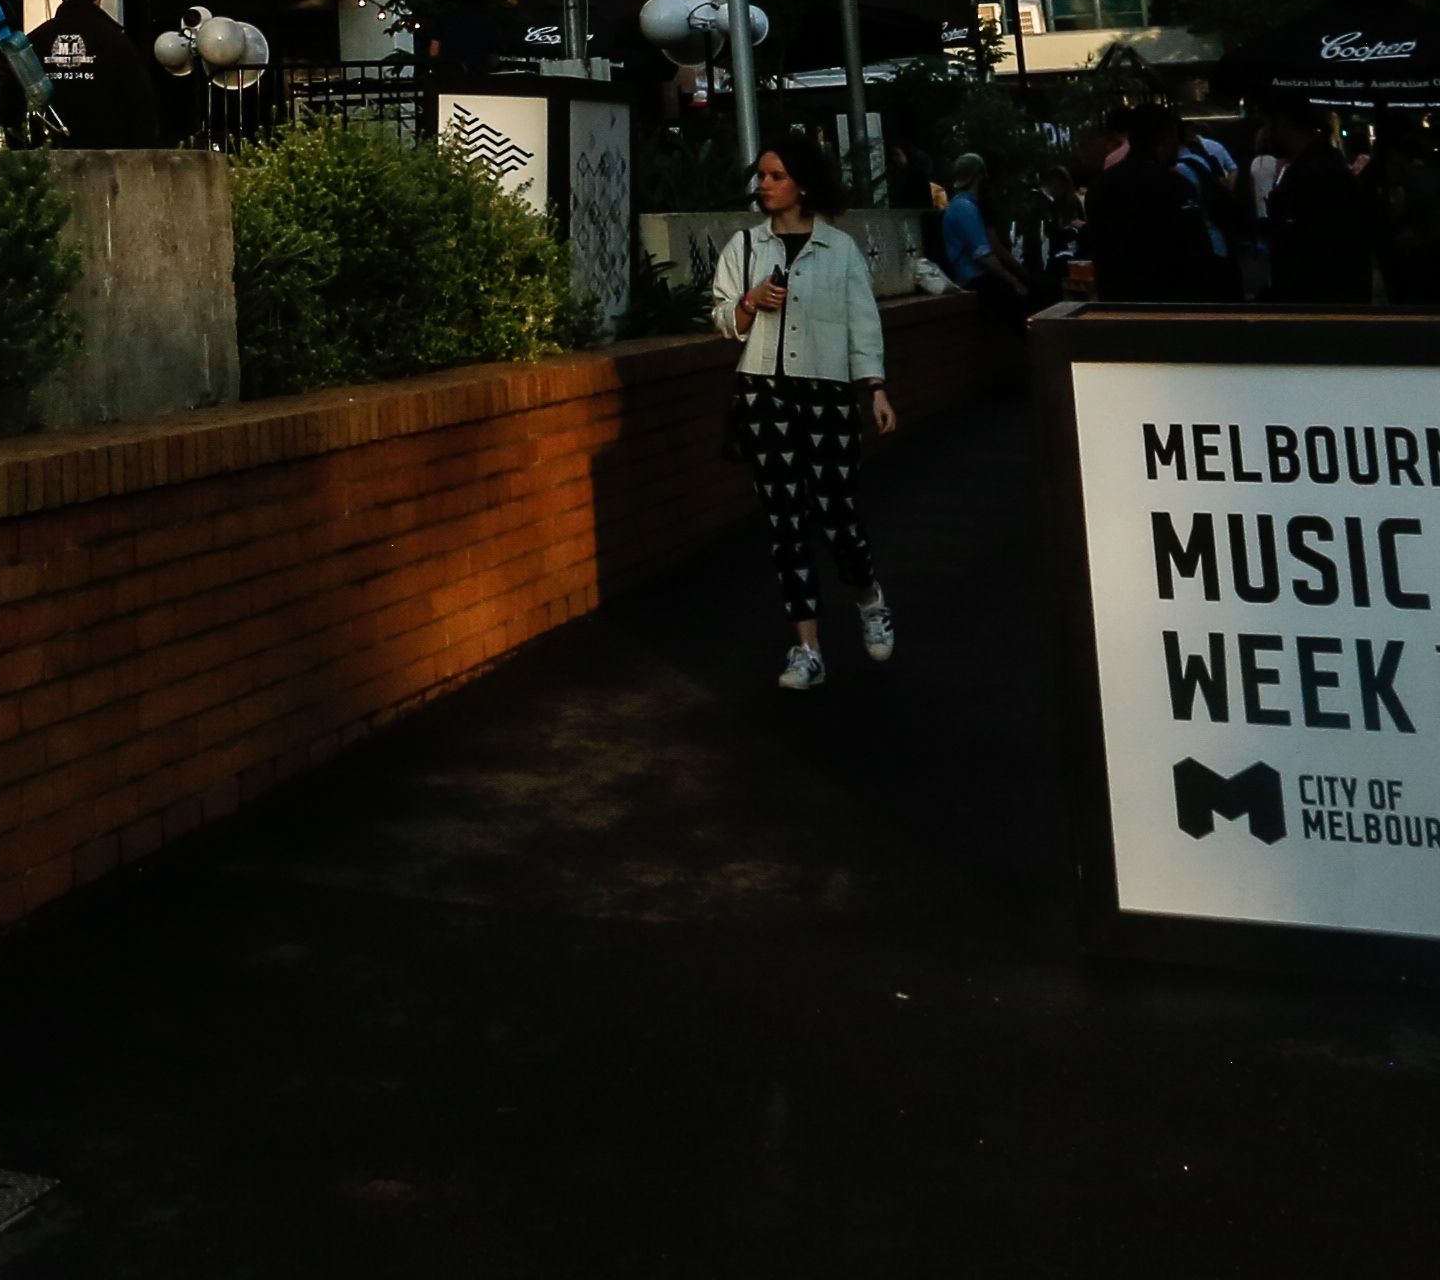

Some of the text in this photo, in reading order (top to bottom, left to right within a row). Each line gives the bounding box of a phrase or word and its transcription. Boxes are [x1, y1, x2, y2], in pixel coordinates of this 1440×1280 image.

[1320, 31, 1417, 62] Coopers
[1272, 77, 1331, 88] Australian
[1370, 80, 1429, 89] Australian
[1151, 512, 1431, 611] MUSIC
[1163, 631, 1416, 735] WEEK
[1299, 775, 1403, 811] CITY OF
